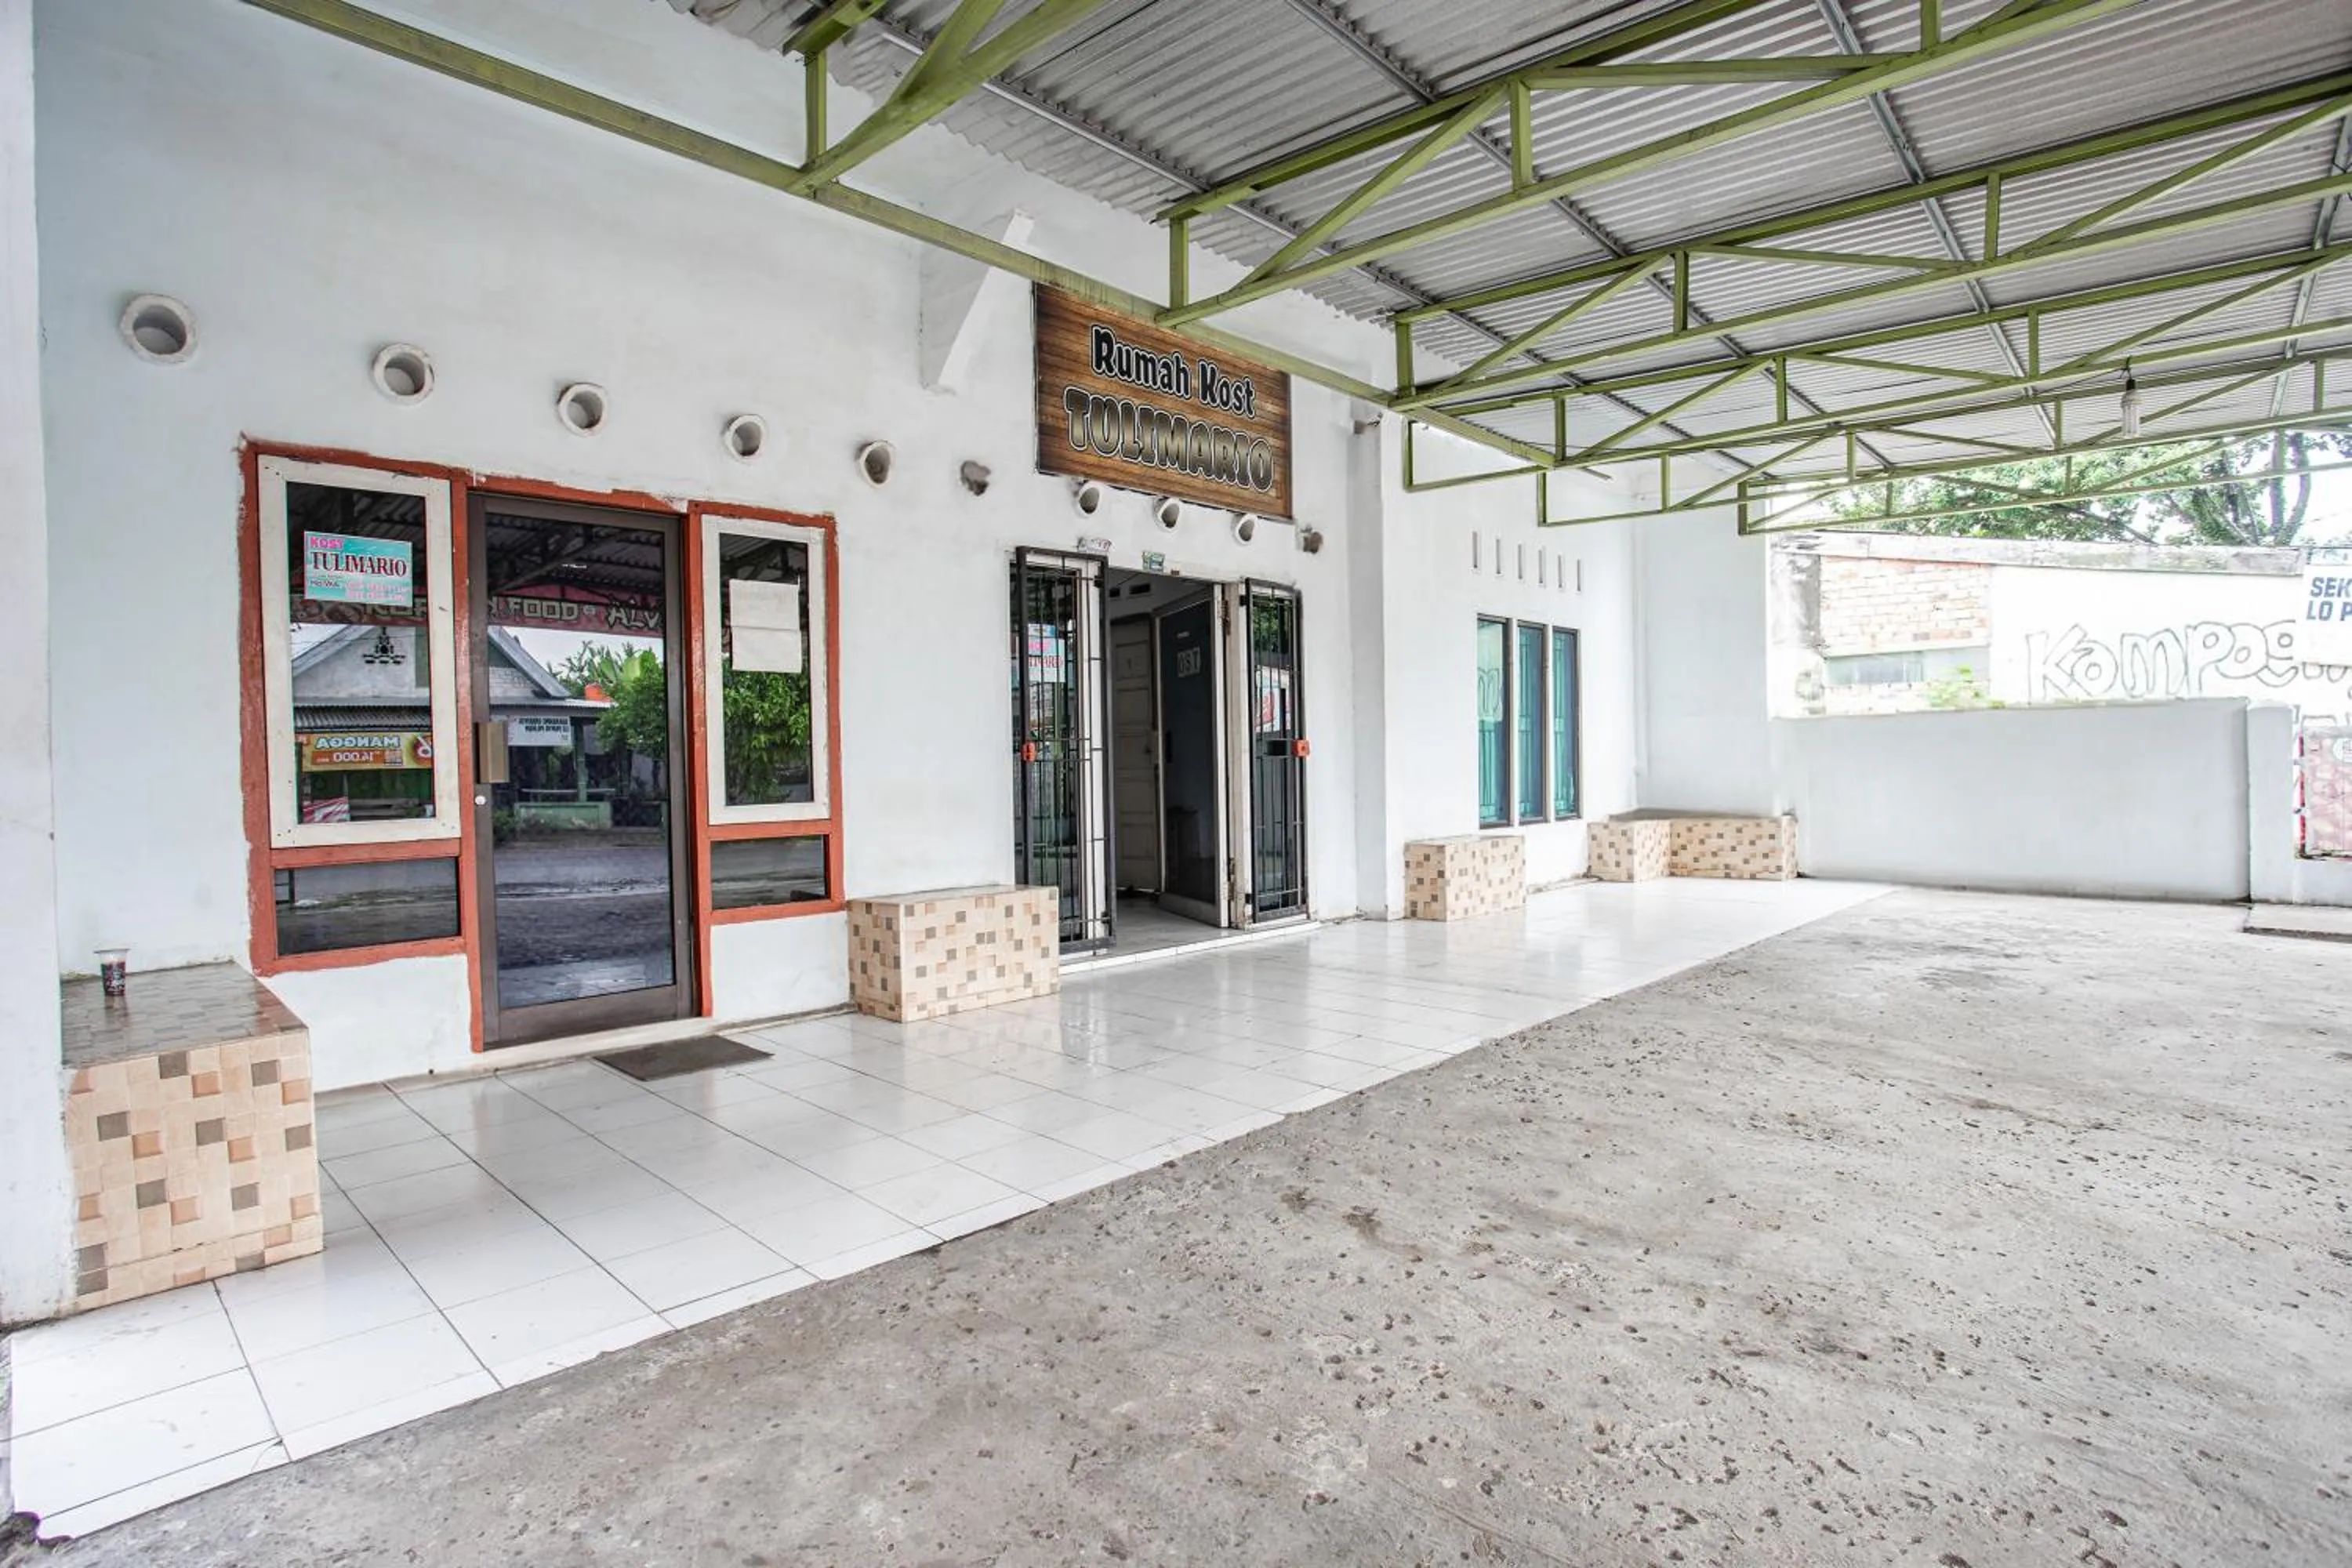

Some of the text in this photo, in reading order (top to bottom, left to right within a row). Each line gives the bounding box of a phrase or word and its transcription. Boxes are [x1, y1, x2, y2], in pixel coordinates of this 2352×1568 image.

[1091, 325, 1255, 419] Rumah Kost
[1064, 387, 1273, 492] TULIMARIO
[310, 551, 407, 576] TULIMARIO
[510, 597, 579, 621] FOOD
[2307, 600, 2333, 621] LO
